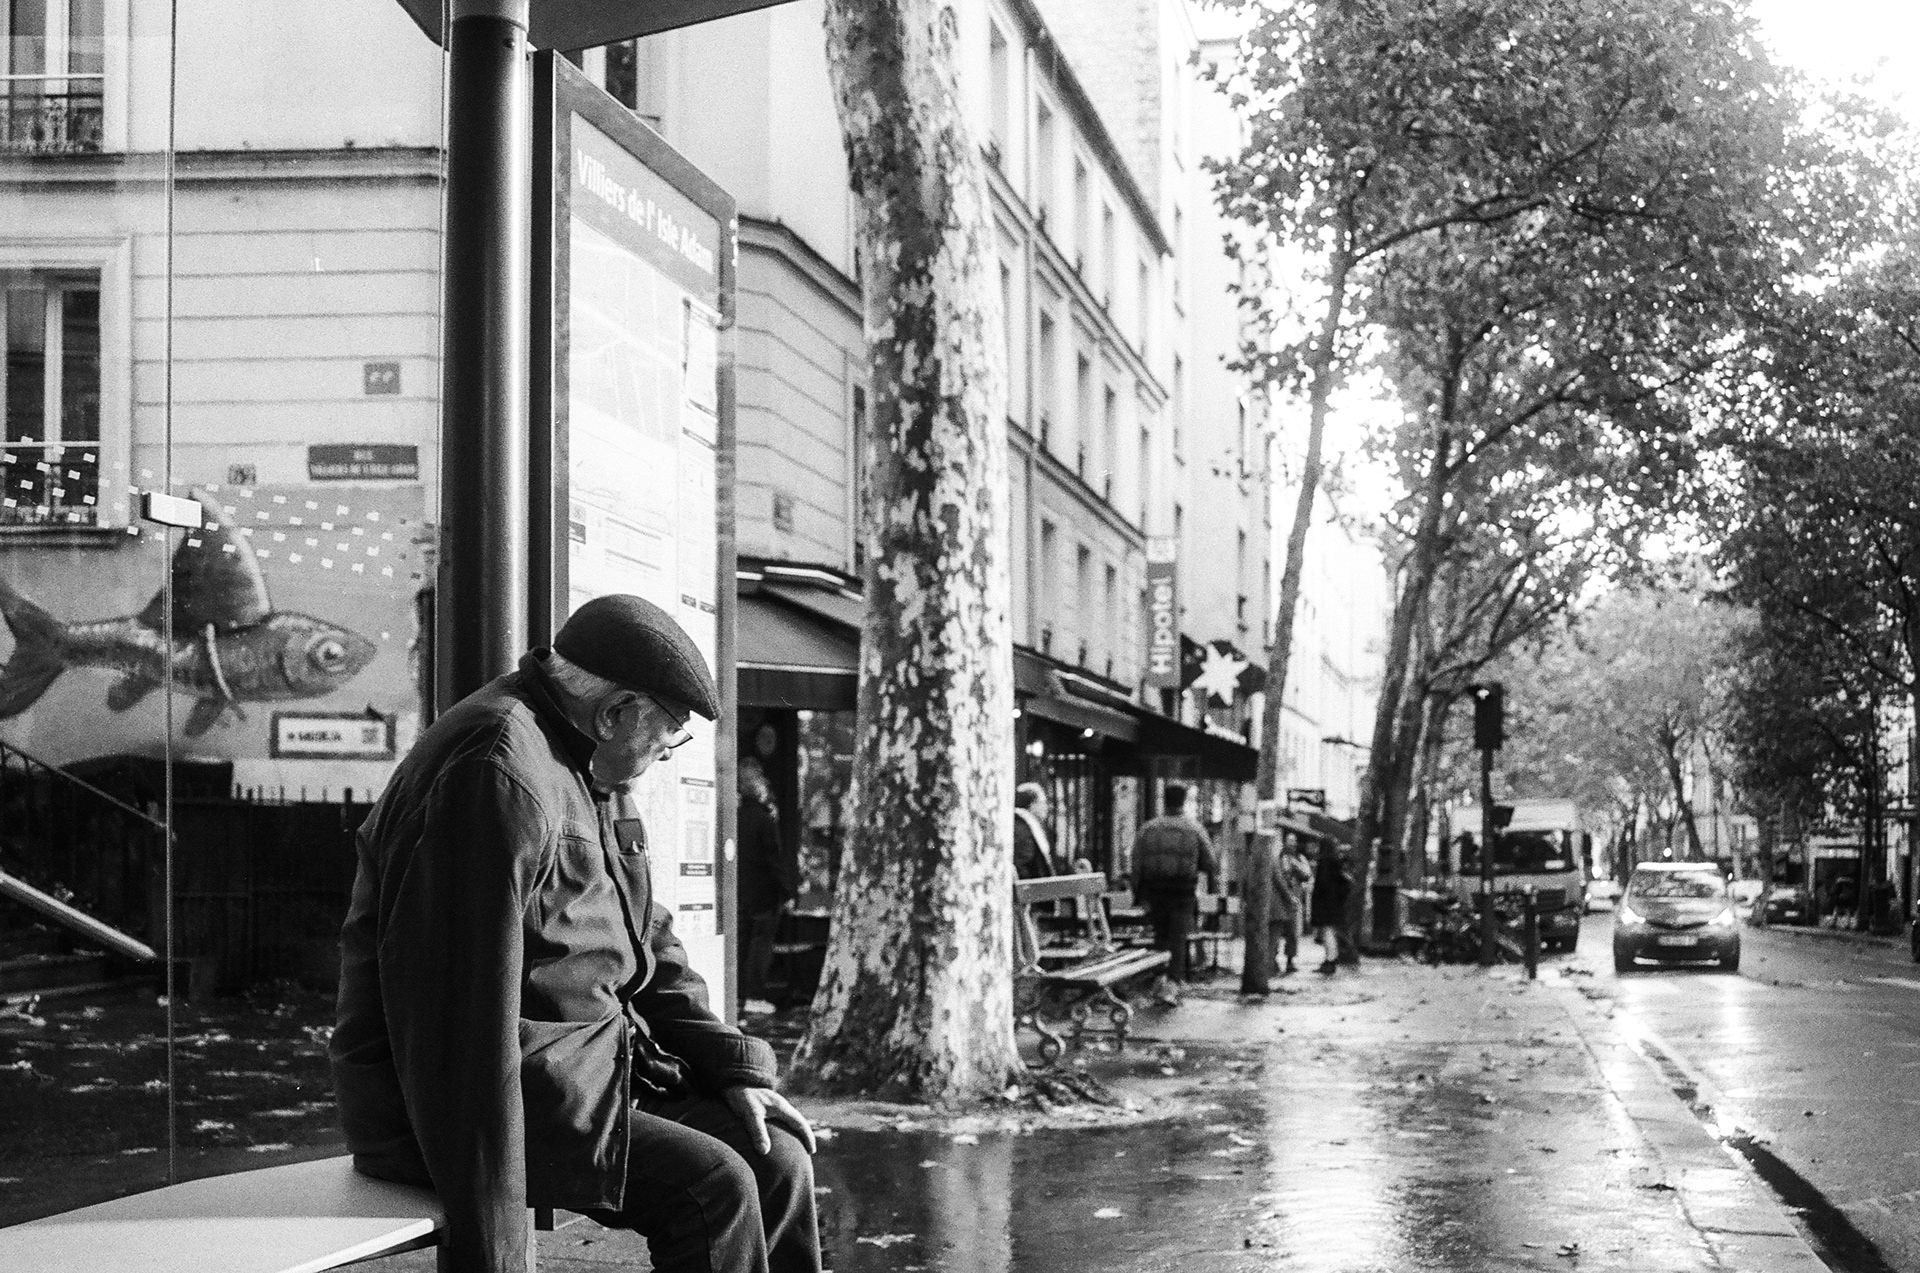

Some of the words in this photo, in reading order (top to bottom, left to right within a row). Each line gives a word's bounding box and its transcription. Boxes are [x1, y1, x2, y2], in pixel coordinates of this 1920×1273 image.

[577, 149, 625, 213] Villiers
[627, 188, 645, 226] de
[680, 226, 714, 274] Adam
[1150, 575, 1175, 675] Hipotel
